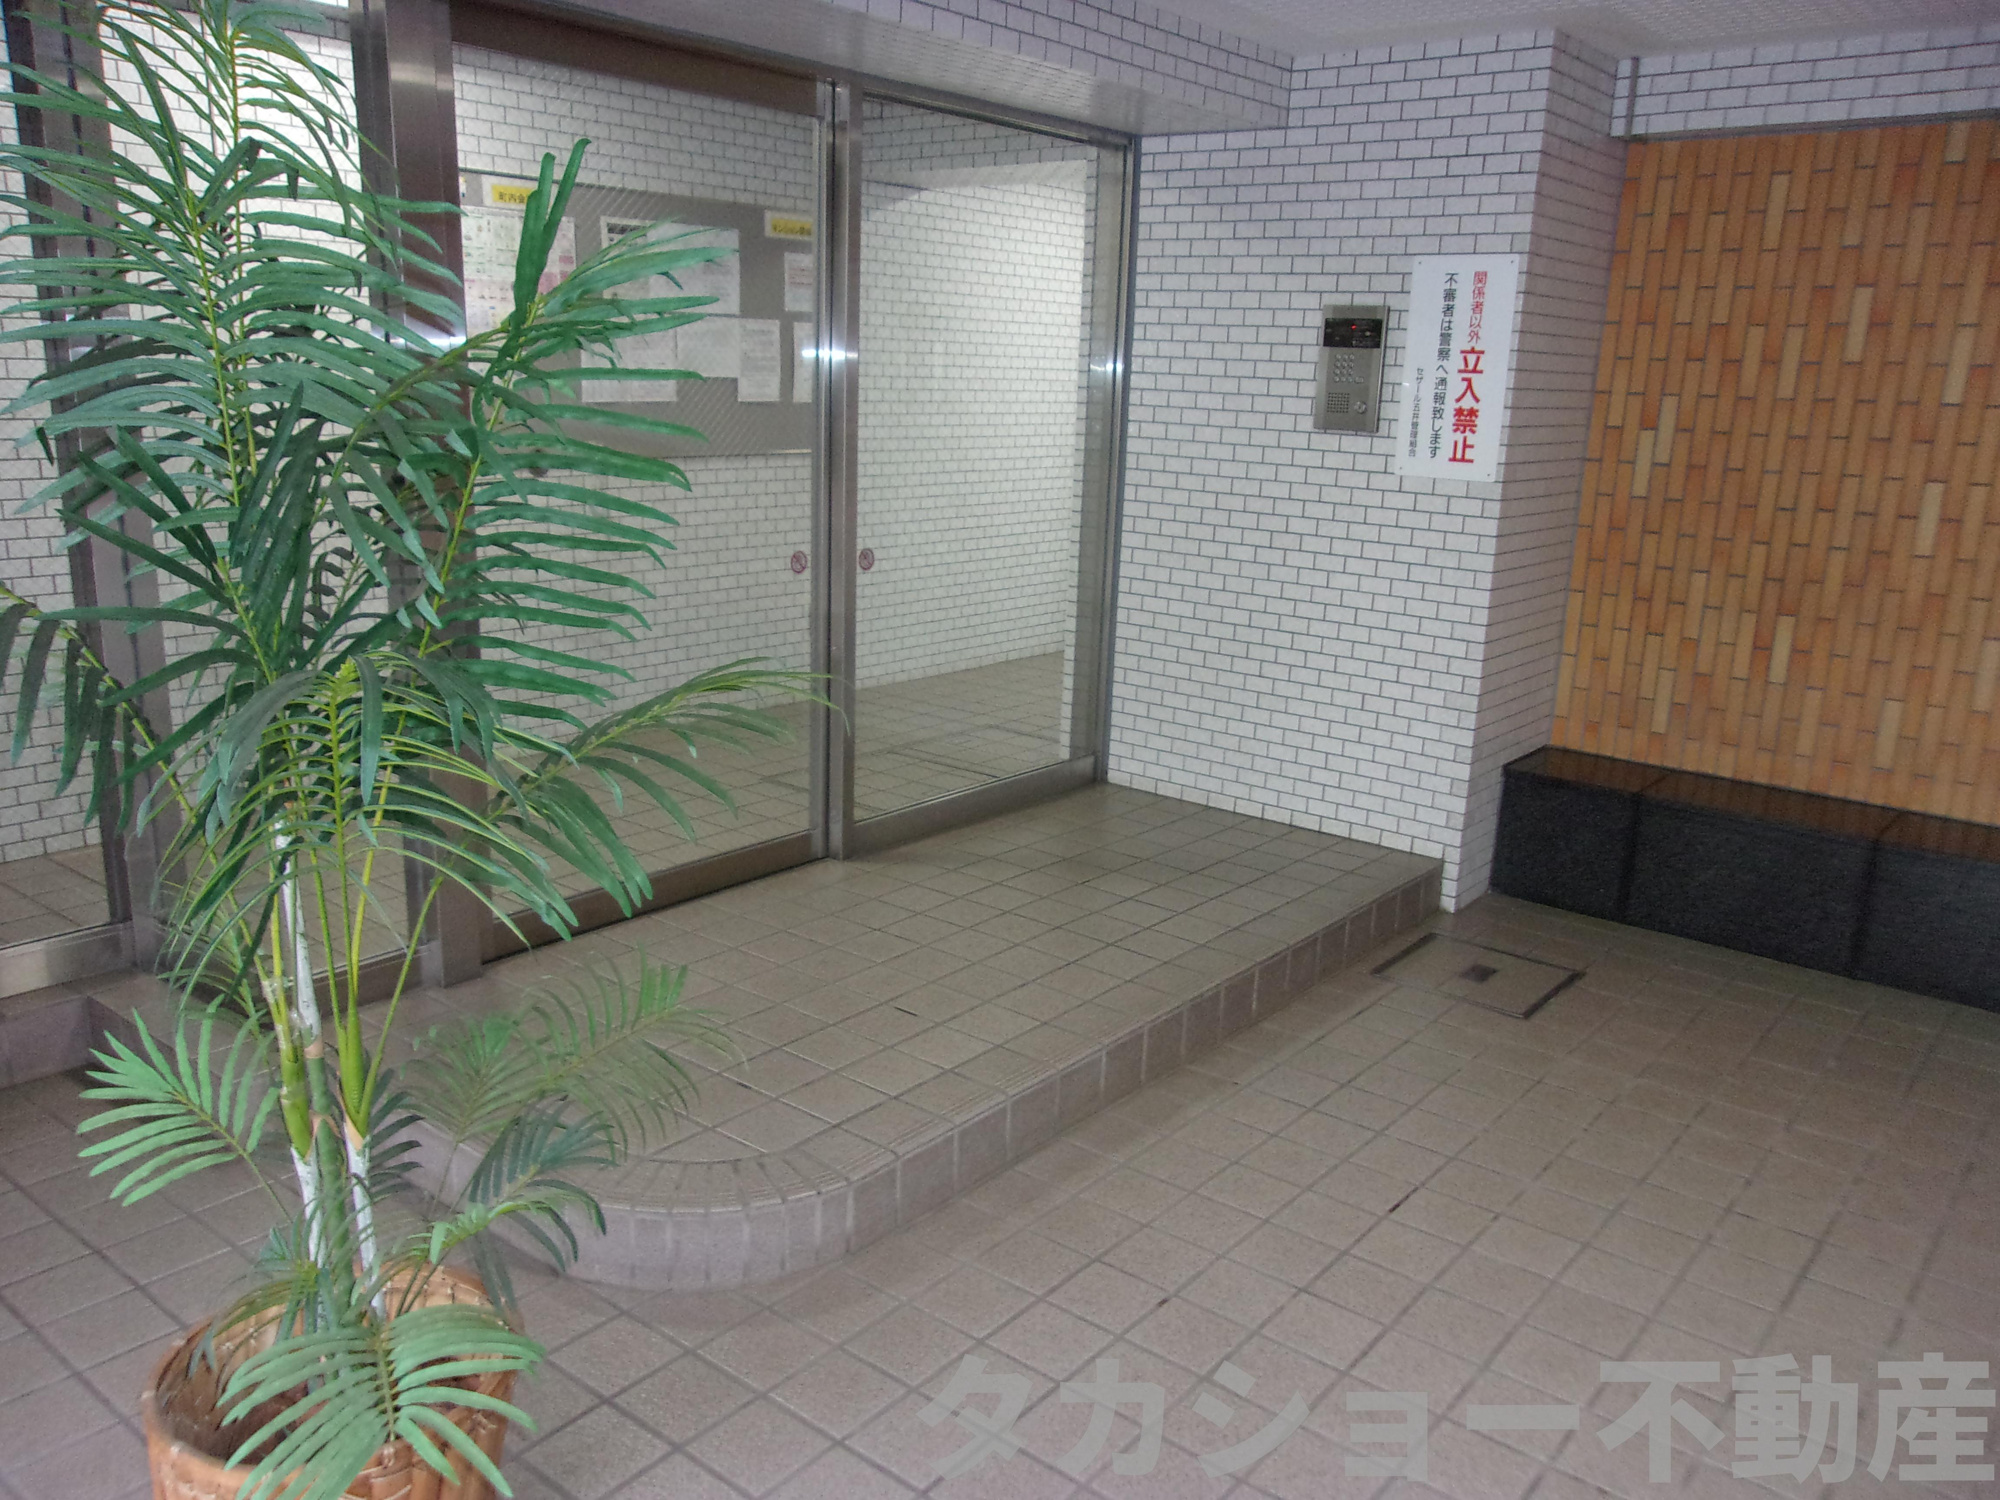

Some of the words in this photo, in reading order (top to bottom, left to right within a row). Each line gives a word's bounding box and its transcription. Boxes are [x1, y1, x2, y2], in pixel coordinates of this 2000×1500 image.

[1428, 272, 1459, 459] 不審者は警察へ通報致します
